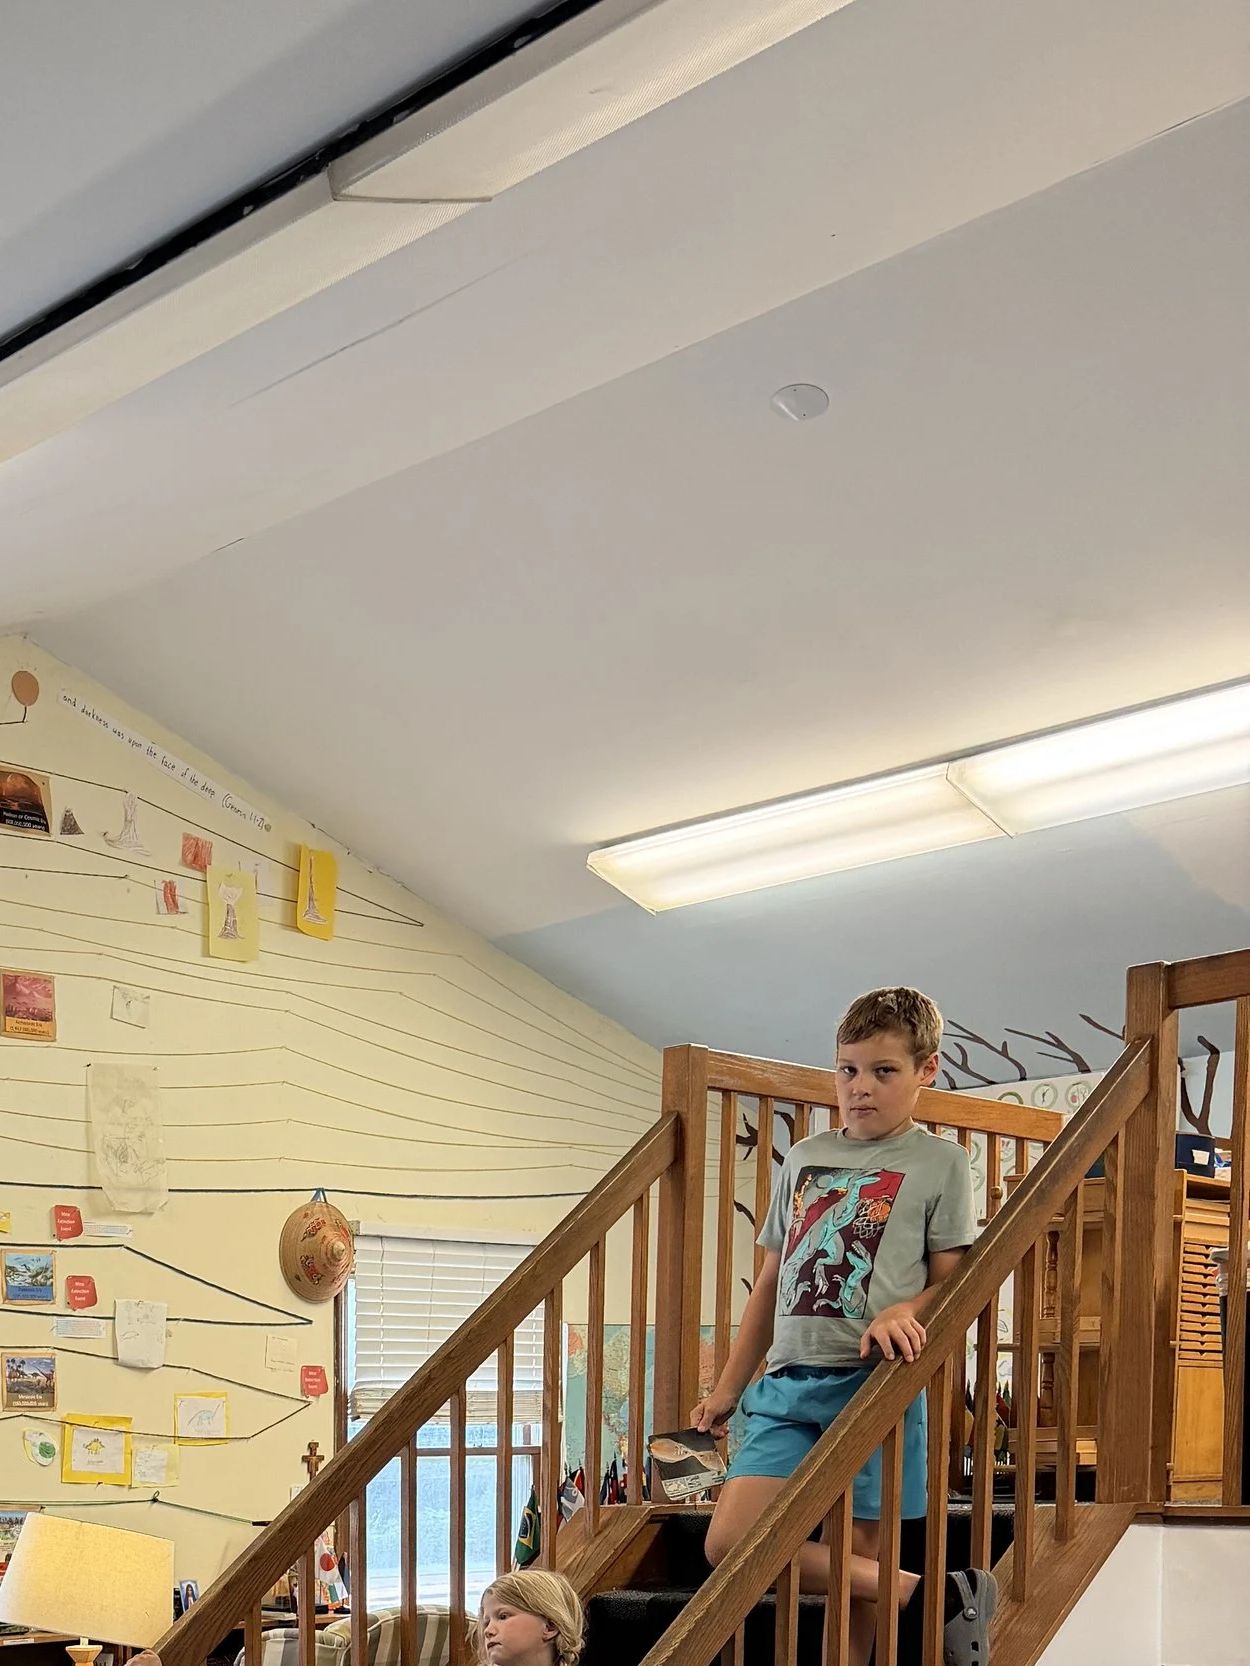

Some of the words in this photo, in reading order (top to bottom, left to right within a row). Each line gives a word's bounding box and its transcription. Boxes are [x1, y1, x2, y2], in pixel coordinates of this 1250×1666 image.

[62, 695, 77, 707] and
[80, 704, 109, 729] darkness
[112, 727, 125, 740] was
[128, 737, 142, 748] upon
[146, 745, 157, 759] the
[160, 755, 176, 771] face
[180, 767, 190, 778] of
[190, 774, 199, 787] the
